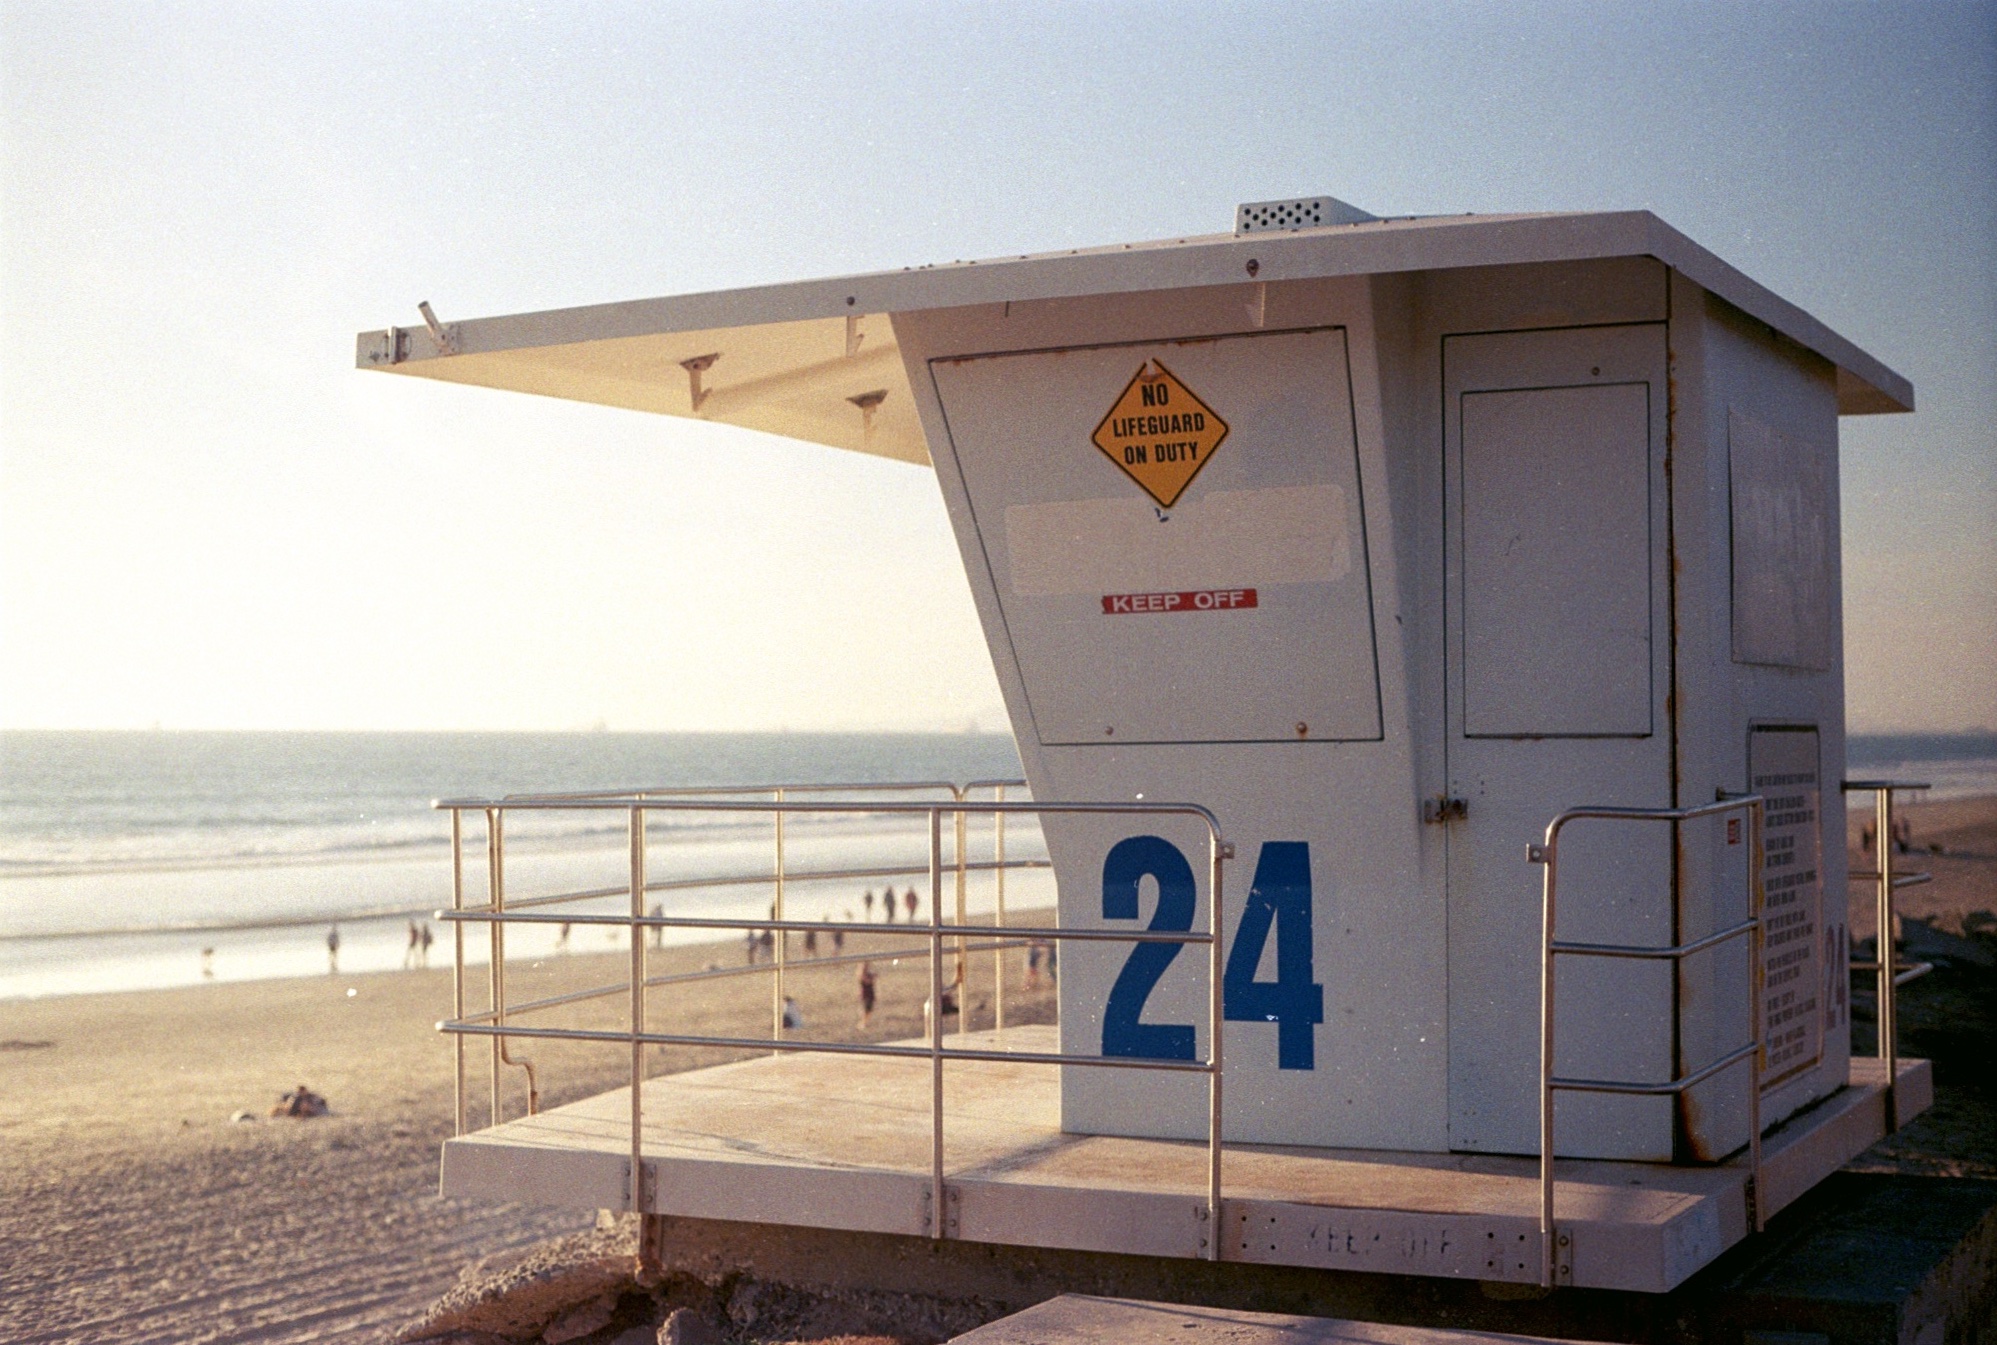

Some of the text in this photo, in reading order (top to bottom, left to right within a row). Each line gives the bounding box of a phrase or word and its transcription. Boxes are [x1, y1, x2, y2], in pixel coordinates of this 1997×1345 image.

[1142, 384, 1168, 406] NO
[1113, 412, 1205, 437] LIFEGUARD
[1124, 442, 1198, 465] ON DUTY
[1112, 590, 1244, 612] KEEP OFF
[1101, 834, 1324, 1071] 24
[1825, 922, 1846, 1030] 24
